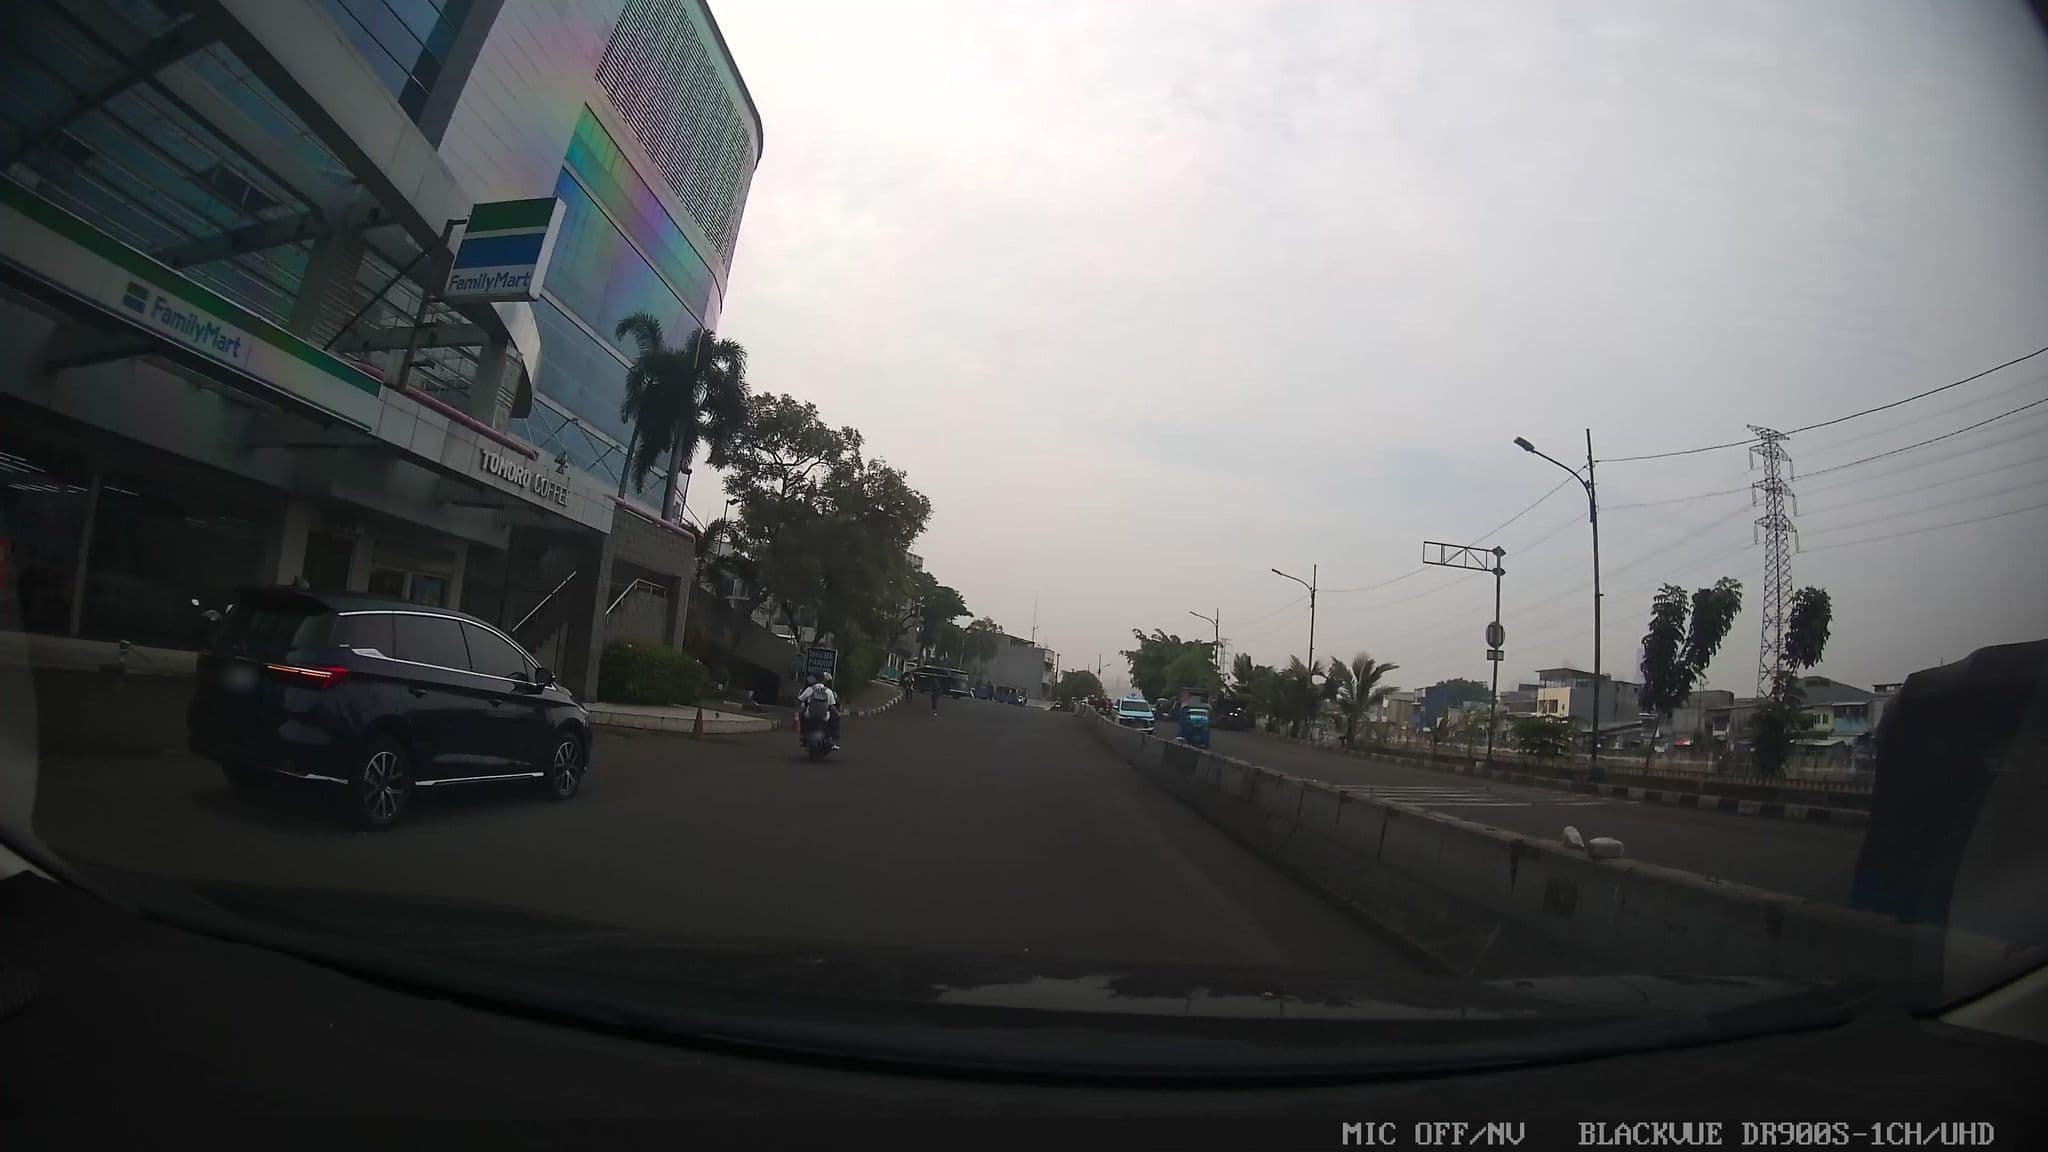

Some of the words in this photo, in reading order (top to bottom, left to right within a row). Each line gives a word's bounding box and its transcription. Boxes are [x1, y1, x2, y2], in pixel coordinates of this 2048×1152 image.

[449, 272, 530, 291] FamilyMart
[150, 296, 241, 358] FamilyMart
[480, 449, 531, 488] TOMORO
